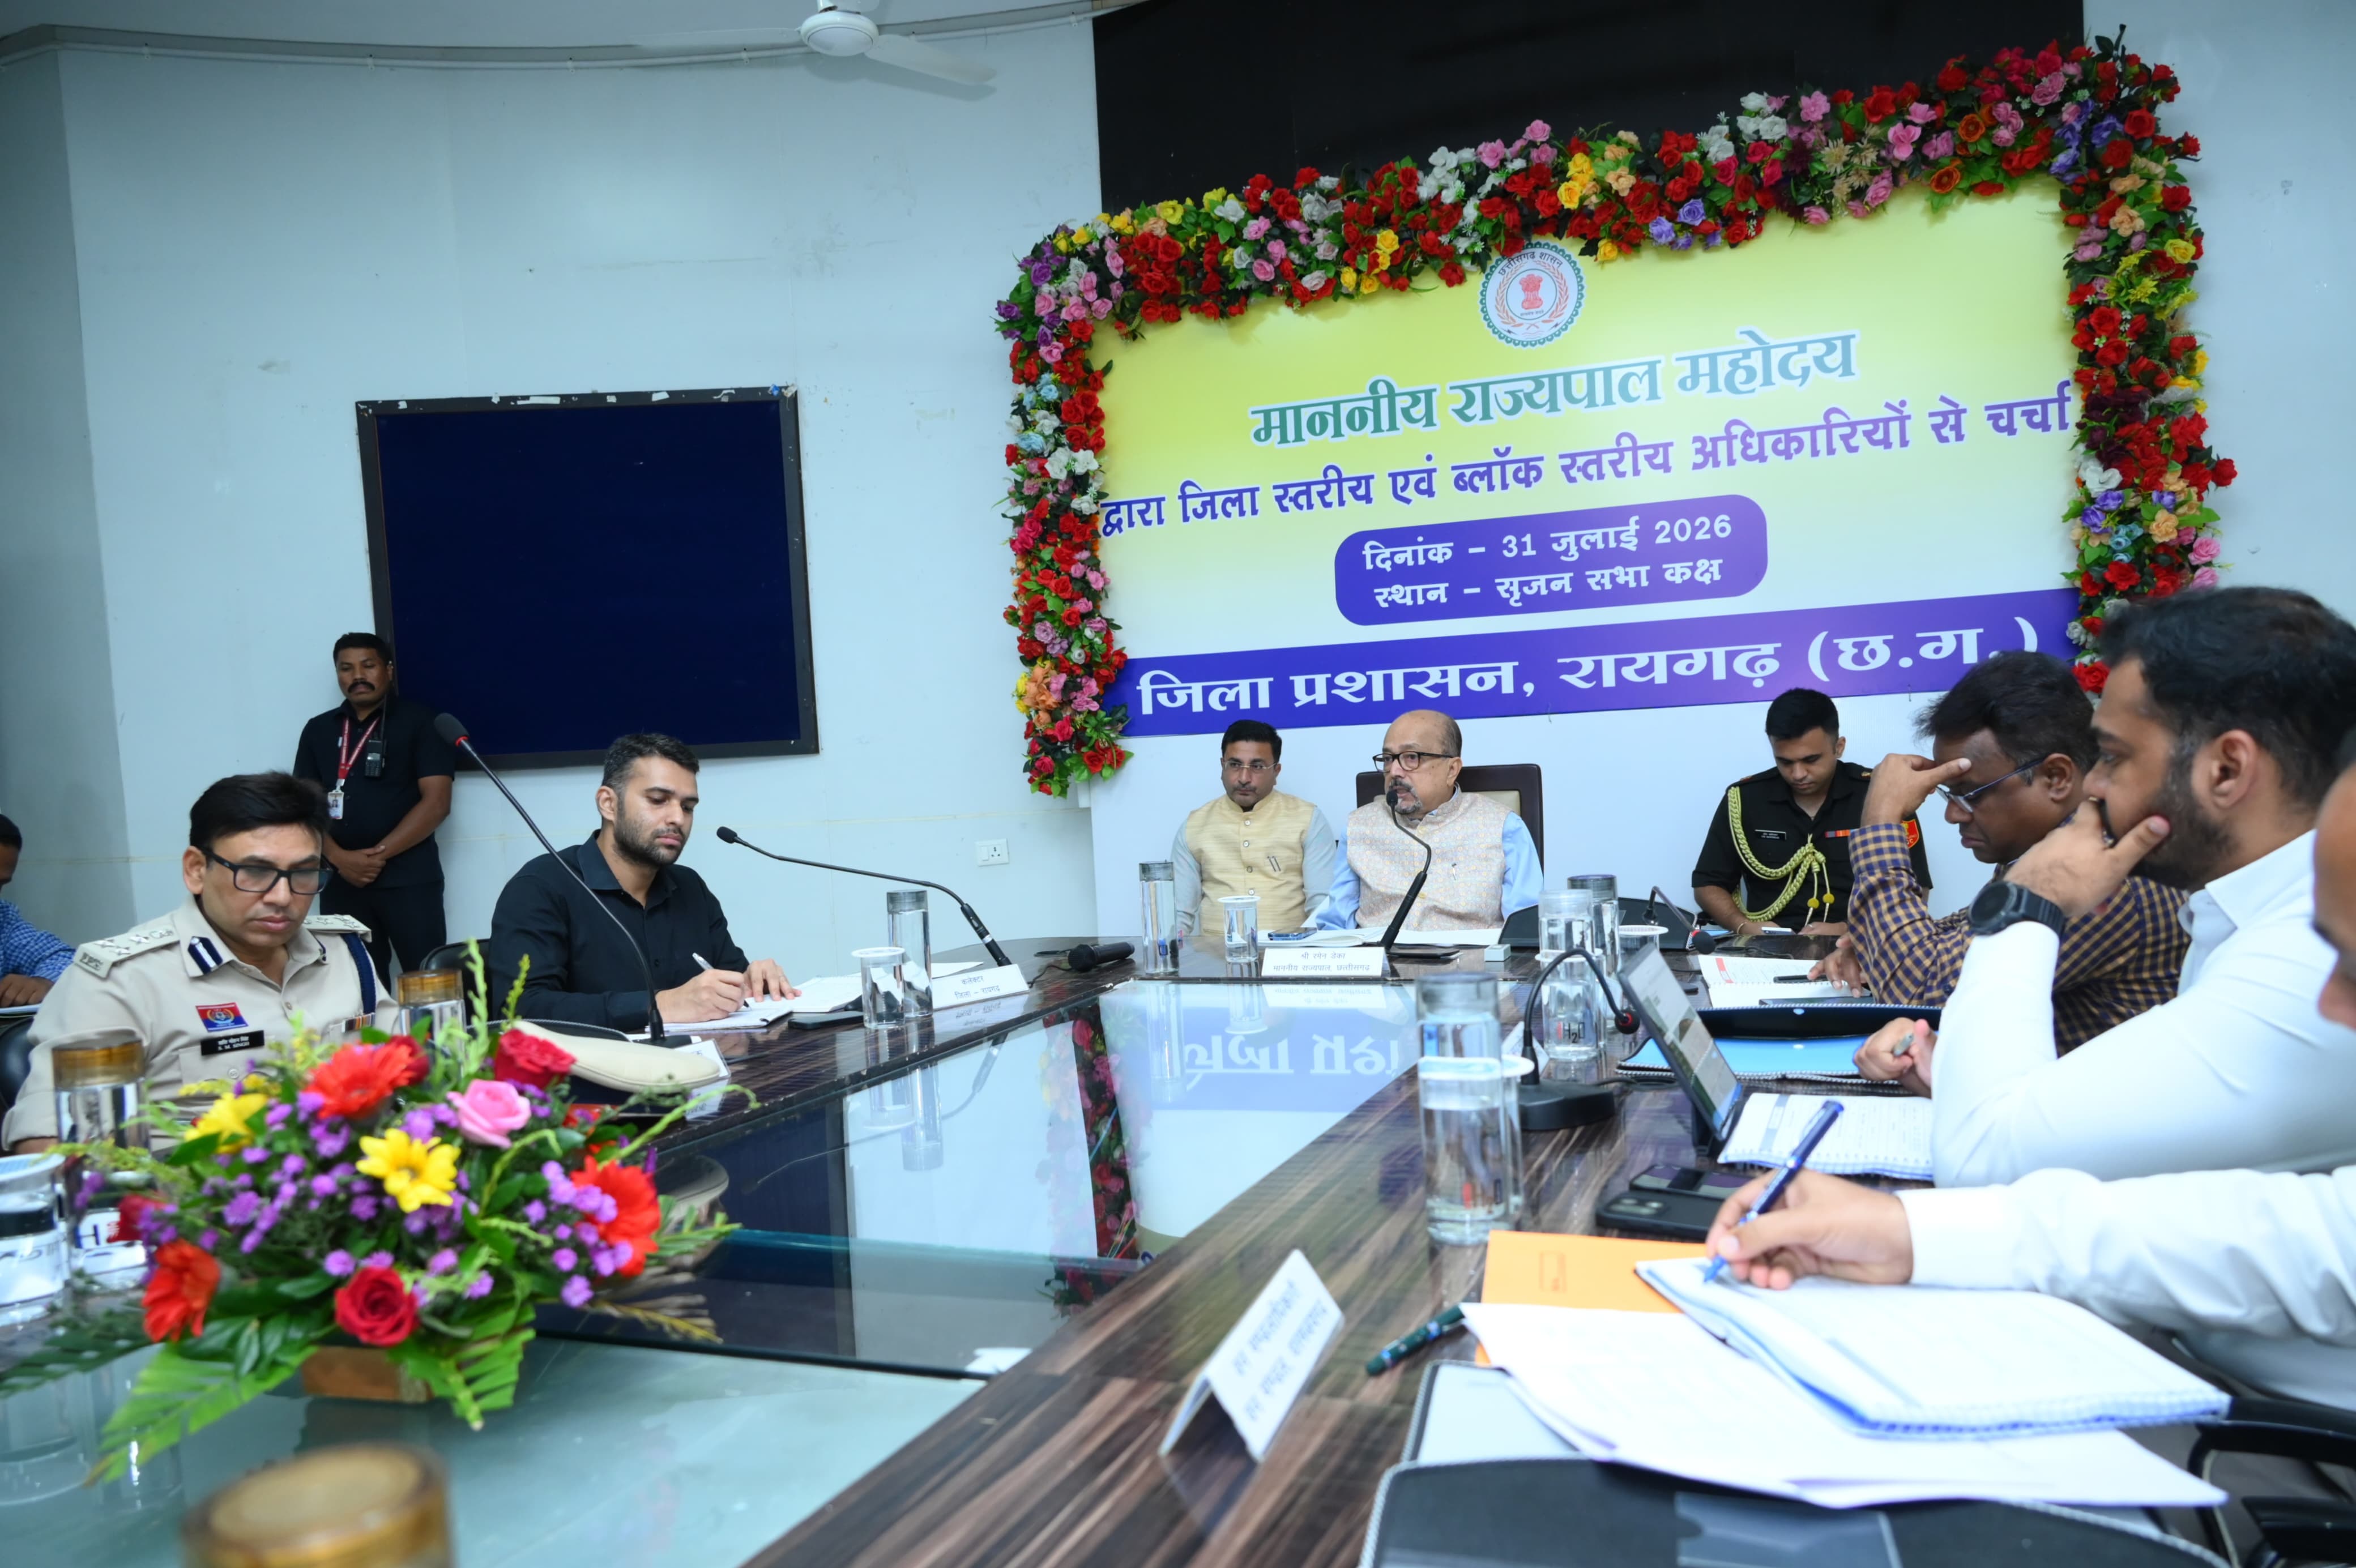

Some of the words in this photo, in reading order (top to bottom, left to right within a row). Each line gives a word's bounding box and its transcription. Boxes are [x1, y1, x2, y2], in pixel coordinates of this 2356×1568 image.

[1251, 379, 1437, 445] माननीय
[1449, 361, 1661, 422] राज्यपाल
[1676, 330, 1856, 394] महोदय
[1100, 497, 1165, 536] द्वारा
[1179, 480, 1260, 522] जिला
[1273, 464, 1374, 512] स्तरीय
[1388, 454, 1437, 505] एवं
[1451, 447, 1544, 493] ब्लॉक
[1559, 432, 1673, 484] स्तरीय
[1691, 400, 1911, 470] अधिकारियों
[1928, 395, 1967, 443] से
[1984, 381, 2071, 437] चर्चा
[1362, 536, 1453, 571] दिनांक
[1503, 533, 1536, 557] 31
[1550, 518, 1640, 562] जुलाई
[1655, 515, 1731, 545] 2026
[1374, 582, 1449, 608] स्थान
[1495, 572, 1573, 606] सृजन
[1585, 565, 1650, 591] सभा
[1663, 558, 1723, 586] कक्ष
[1137, 670, 1273, 715] जिला
[1290, 661, 1535, 707] प्रशासन,
[1557, 643, 1781, 689] रायगढ़
